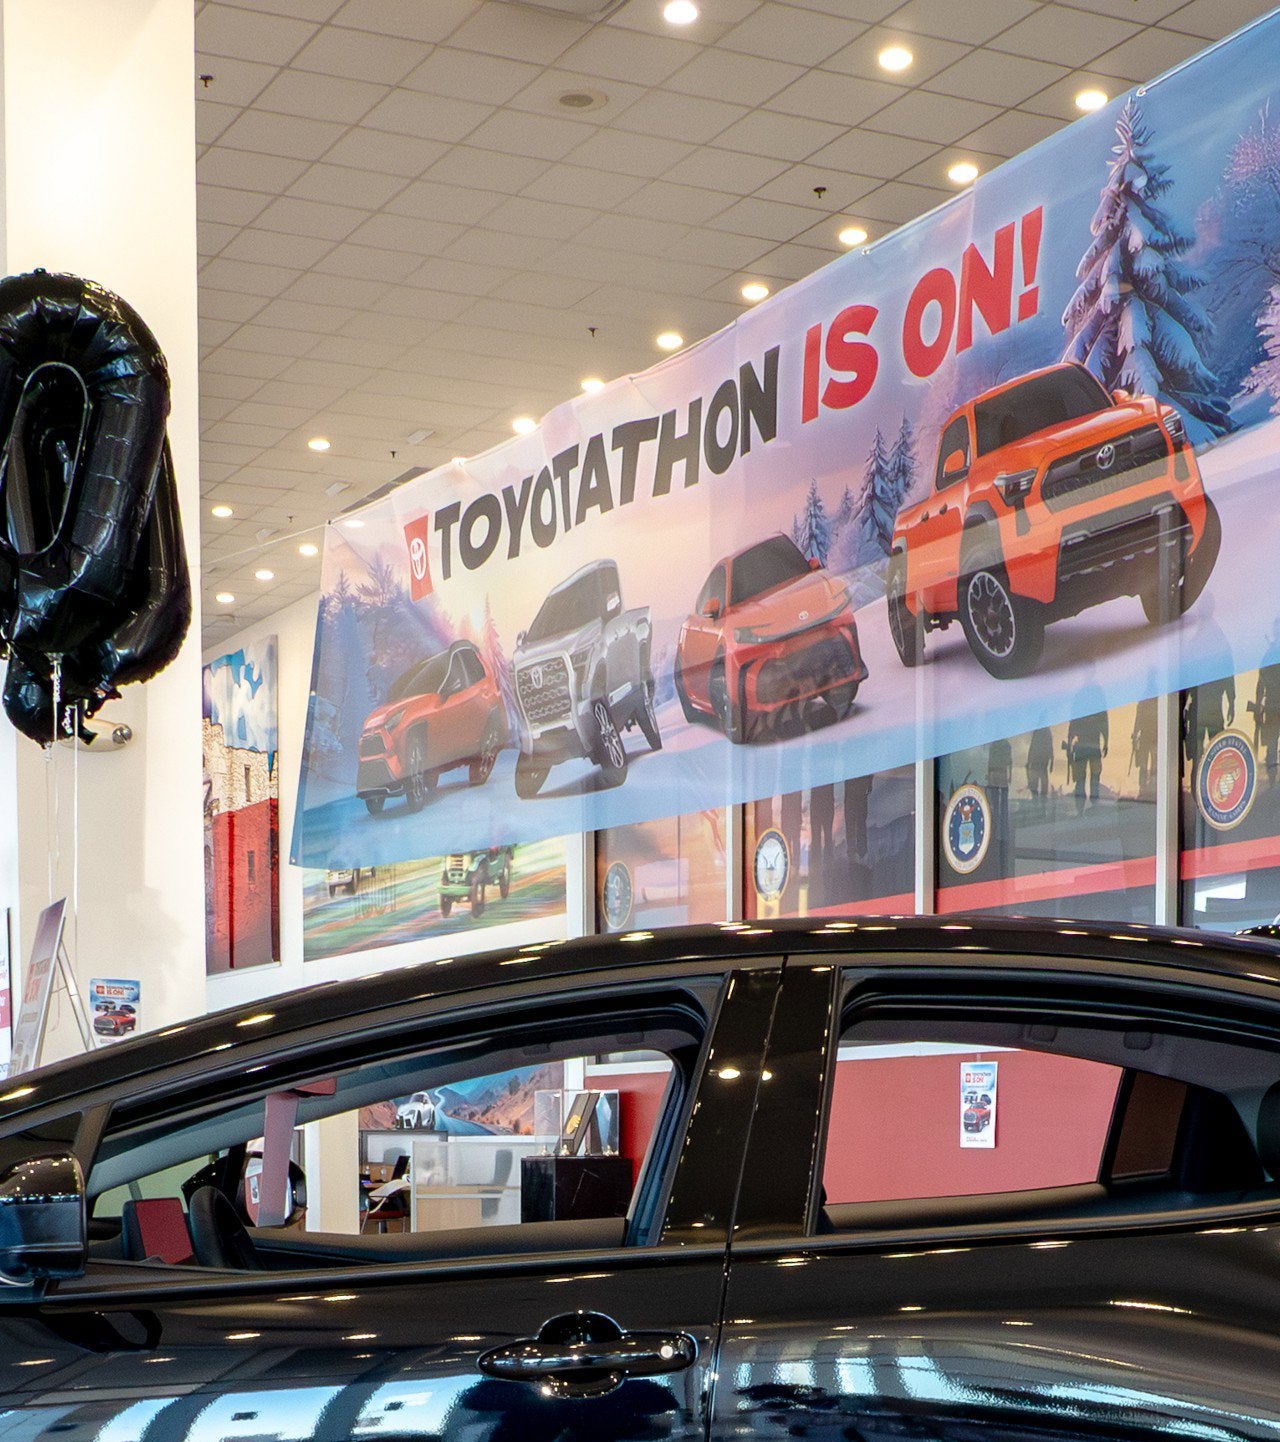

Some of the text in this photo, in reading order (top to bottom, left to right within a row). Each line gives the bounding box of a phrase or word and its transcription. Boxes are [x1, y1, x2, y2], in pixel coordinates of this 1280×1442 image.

[434, 206, 1043, 579] TOYOTATHON IS ON!
